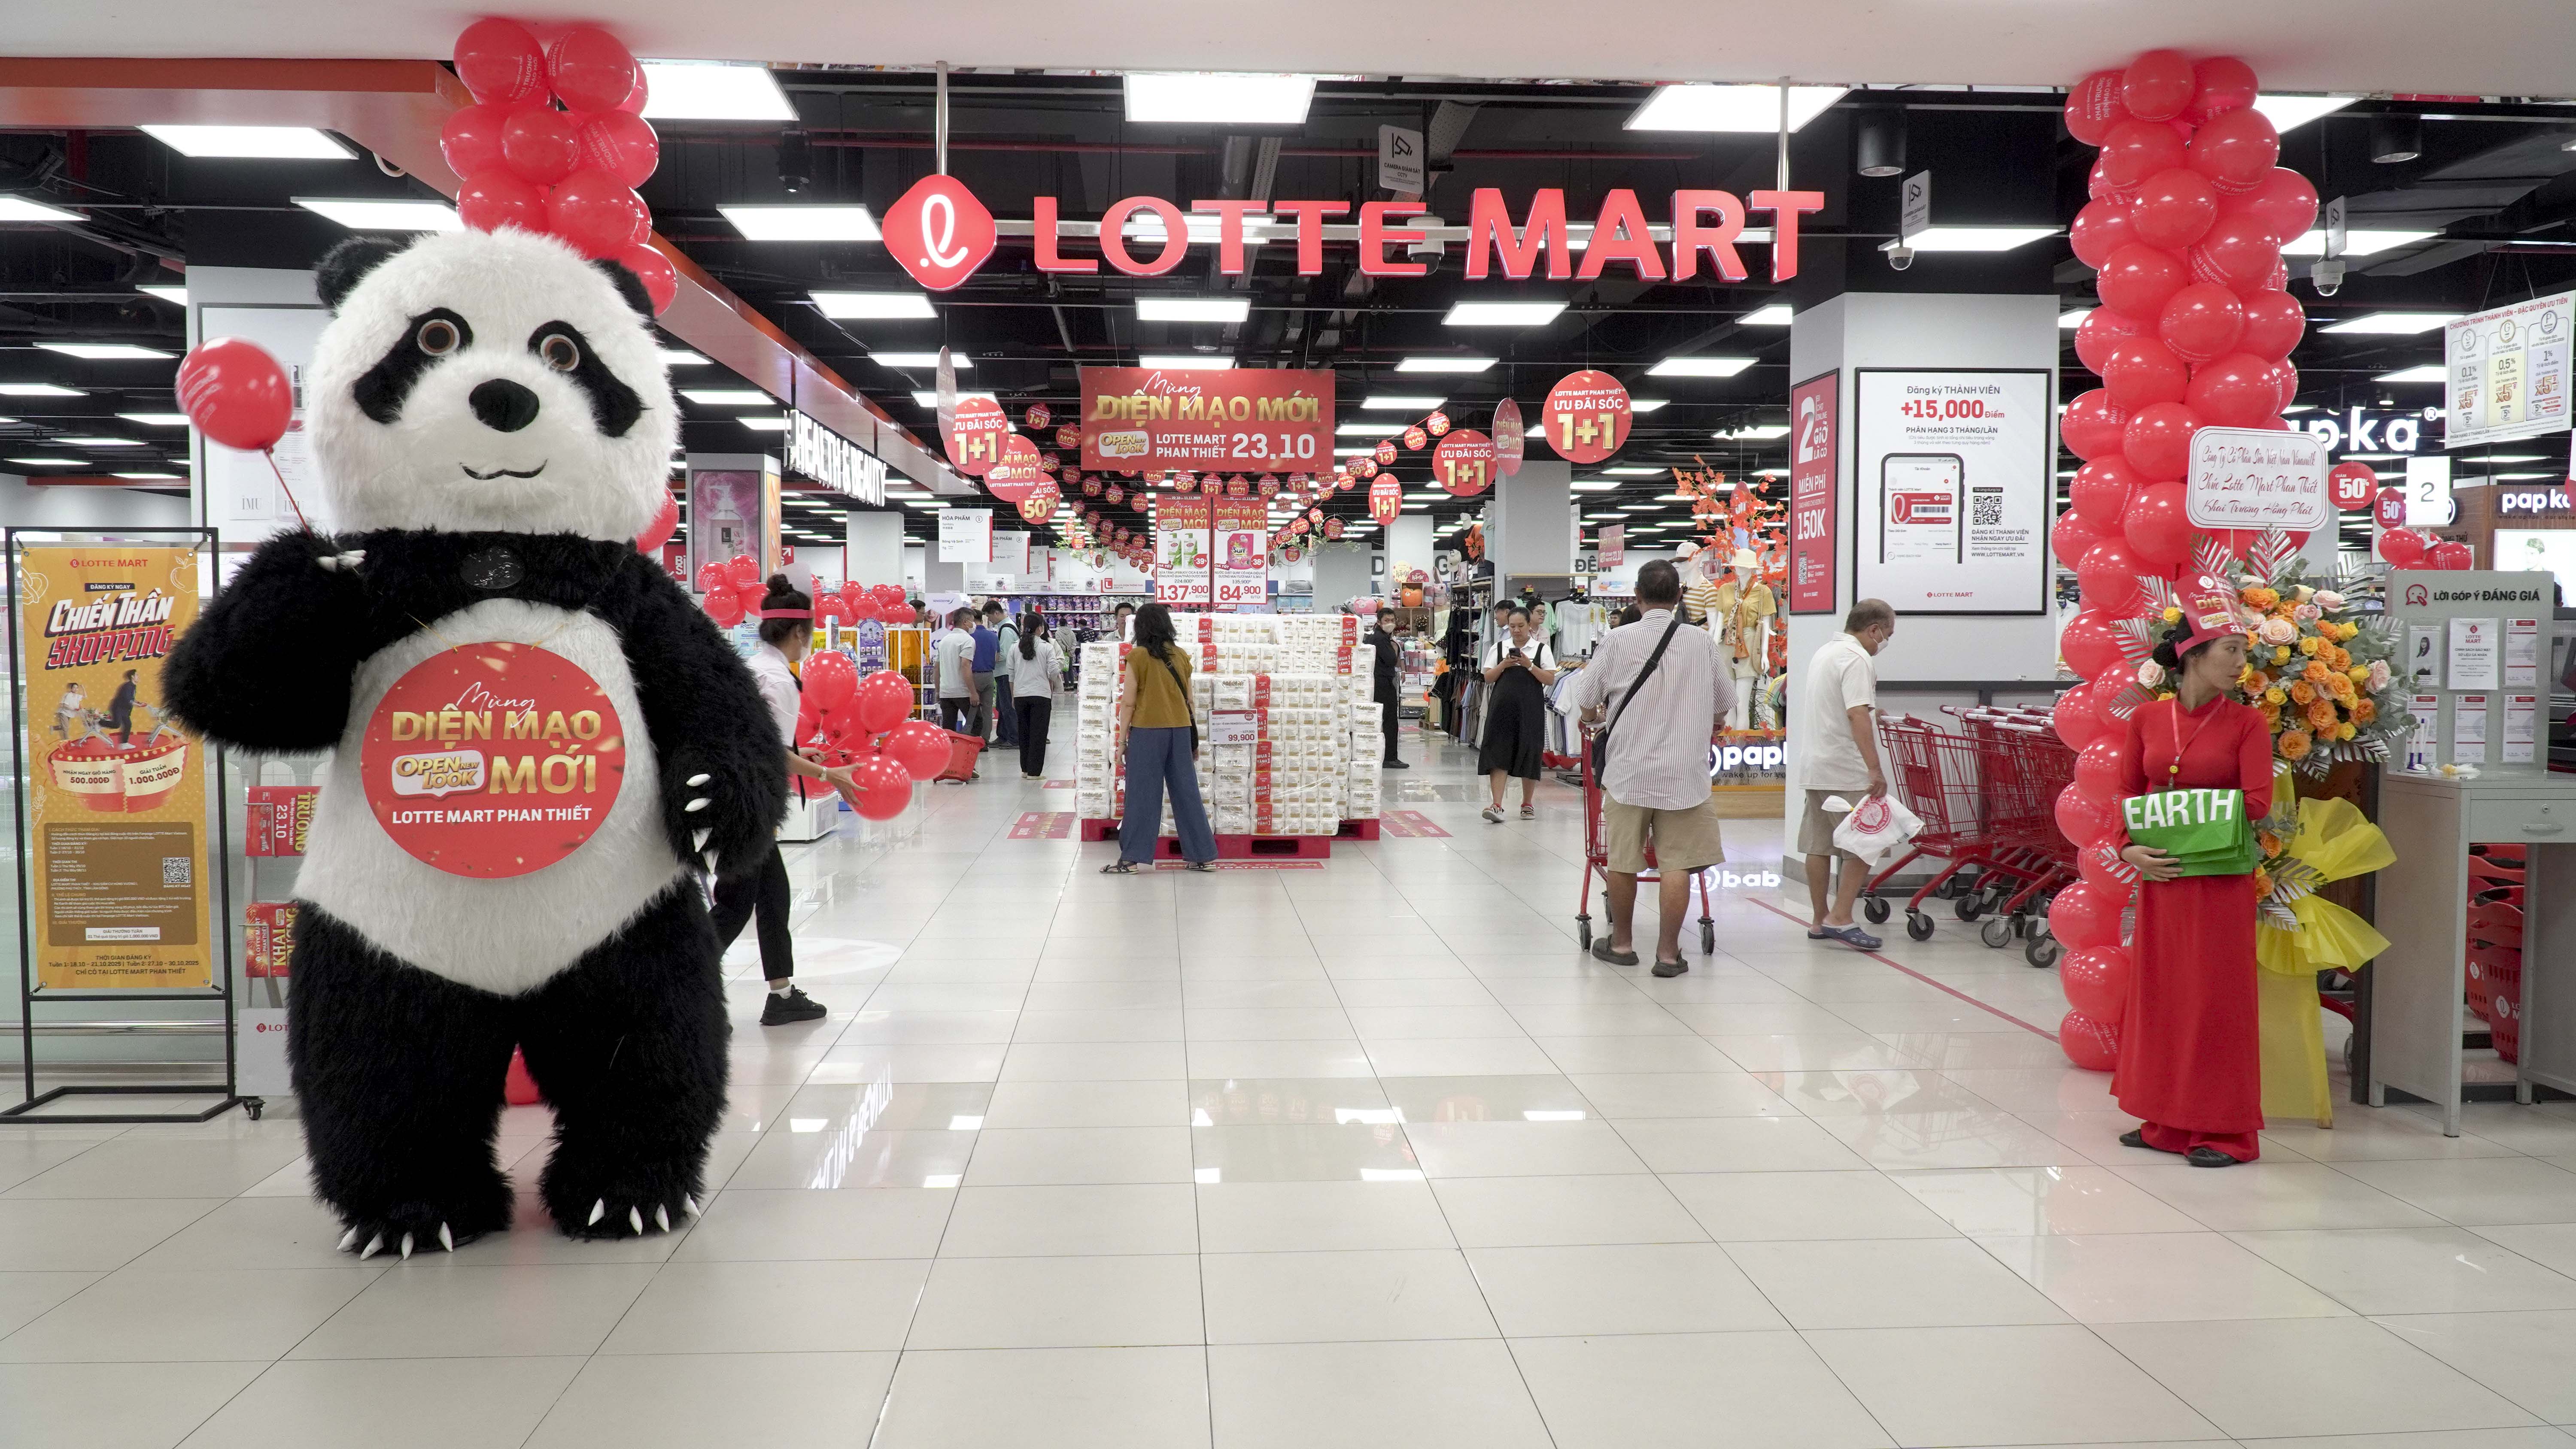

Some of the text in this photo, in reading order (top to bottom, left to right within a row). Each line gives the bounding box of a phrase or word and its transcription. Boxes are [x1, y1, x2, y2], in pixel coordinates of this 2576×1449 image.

[1384, 163, 1401, 171] CAMERA
[1034, 188, 1824, 283] LOTTE MART
[2450, 320, 2469, 330] CHƯƠNG
[2470, 316, 2483, 327] TRÌNH
[2485, 313, 2501, 323] THÀNH
[2502, 309, 2513, 318] VIÊN
[2518, 306, 2528, 315] ĐẶC
[2556, 297, 2568, 305] TIÊN
[2544, 350, 2553, 361] 1%
[1907, 385, 2000, 395] Đăng ký THÀNH VIÊN
[1096, 389, 1318, 428] DIỆN MẠO MỚI
[1554, 397, 1623, 410] ƯU ĐÃI SỐC
[1901, 400, 2005, 421] +15,000 Điểm
[1156, 434, 1226, 445] LOTTE MART
[1558, 412, 1614, 449] 1+1
[1798, 396, 1815, 463] 2
[1814, 421, 1828, 445] GIỜ
[954, 432, 996, 464] 1+1
[1156, 445, 1226, 458] PHAN THIẾT
[1232, 433, 1315, 459] 23.10
[1409, 437, 1423, 446] MỚI
[1814, 443, 1827, 459] LÀ CÓ
[790, 409, 841, 489] HEALTH
[851, 446, 887, 507] BEAUTY
[1378, 452, 1394, 463] 1+1
[1456, 449, 1471, 458] ĐÃI
[1473, 448, 1492, 457] SỐC
[2202, 446, 2216, 468] Công
[2292, 450, 2315, 466] Vinamilk
[1011, 465, 1036, 479] MỚI
[1349, 465, 1366, 476] 50%
[1444, 460, 1485, 486] 1+1
[1176, 481, 1196, 491] 50%
[1798, 469, 1826, 494] MIỄN PHÍ
[2198, 472, 2318, 496] Chúc Lotte Mart Phan Thiết
[2339, 478, 2369, 498] 50%
[2421, 482, 2435, 502] 2
[1024, 497, 1057, 518] 50%
[1159, 507, 1207, 519] DIỆN MẠO
[1374, 497, 1395, 518] 1+1
[2202, 500, 2226, 512] Khai
[2263, 503, 2287, 518] Hồng
[2290, 502, 2312, 515] Phát
[2383, 501, 2401, 519] 50%
[1184, 516, 1207, 529] MỚI
[1798, 508, 1826, 540] 150K
[1158, 585, 1208, 600] 137,900
[1220, 585, 1261, 601] 84,900
[2434, 588, 2540, 601] LỜI GÓP Ý ĐÁNG GIÁ
[48, 587, 175, 634] CHIẾN THẦN
[46, 624, 175, 669] SHOPPING
[392, 703, 601, 749] DIỆN MẠO
[129, 767, 179, 785] 1.000.000Đ
[395, 756, 480, 777] OPEN NEW
[489, 743, 597, 794] MỚI
[422, 770, 477, 790] LOOK
[392, 804, 592, 824] LOTTE MART PHAN THIẾT
[2125, 789, 2237, 829] EARTH
[276, 805, 288, 838] 23.10
[273, 928, 286, 966] KHAI
